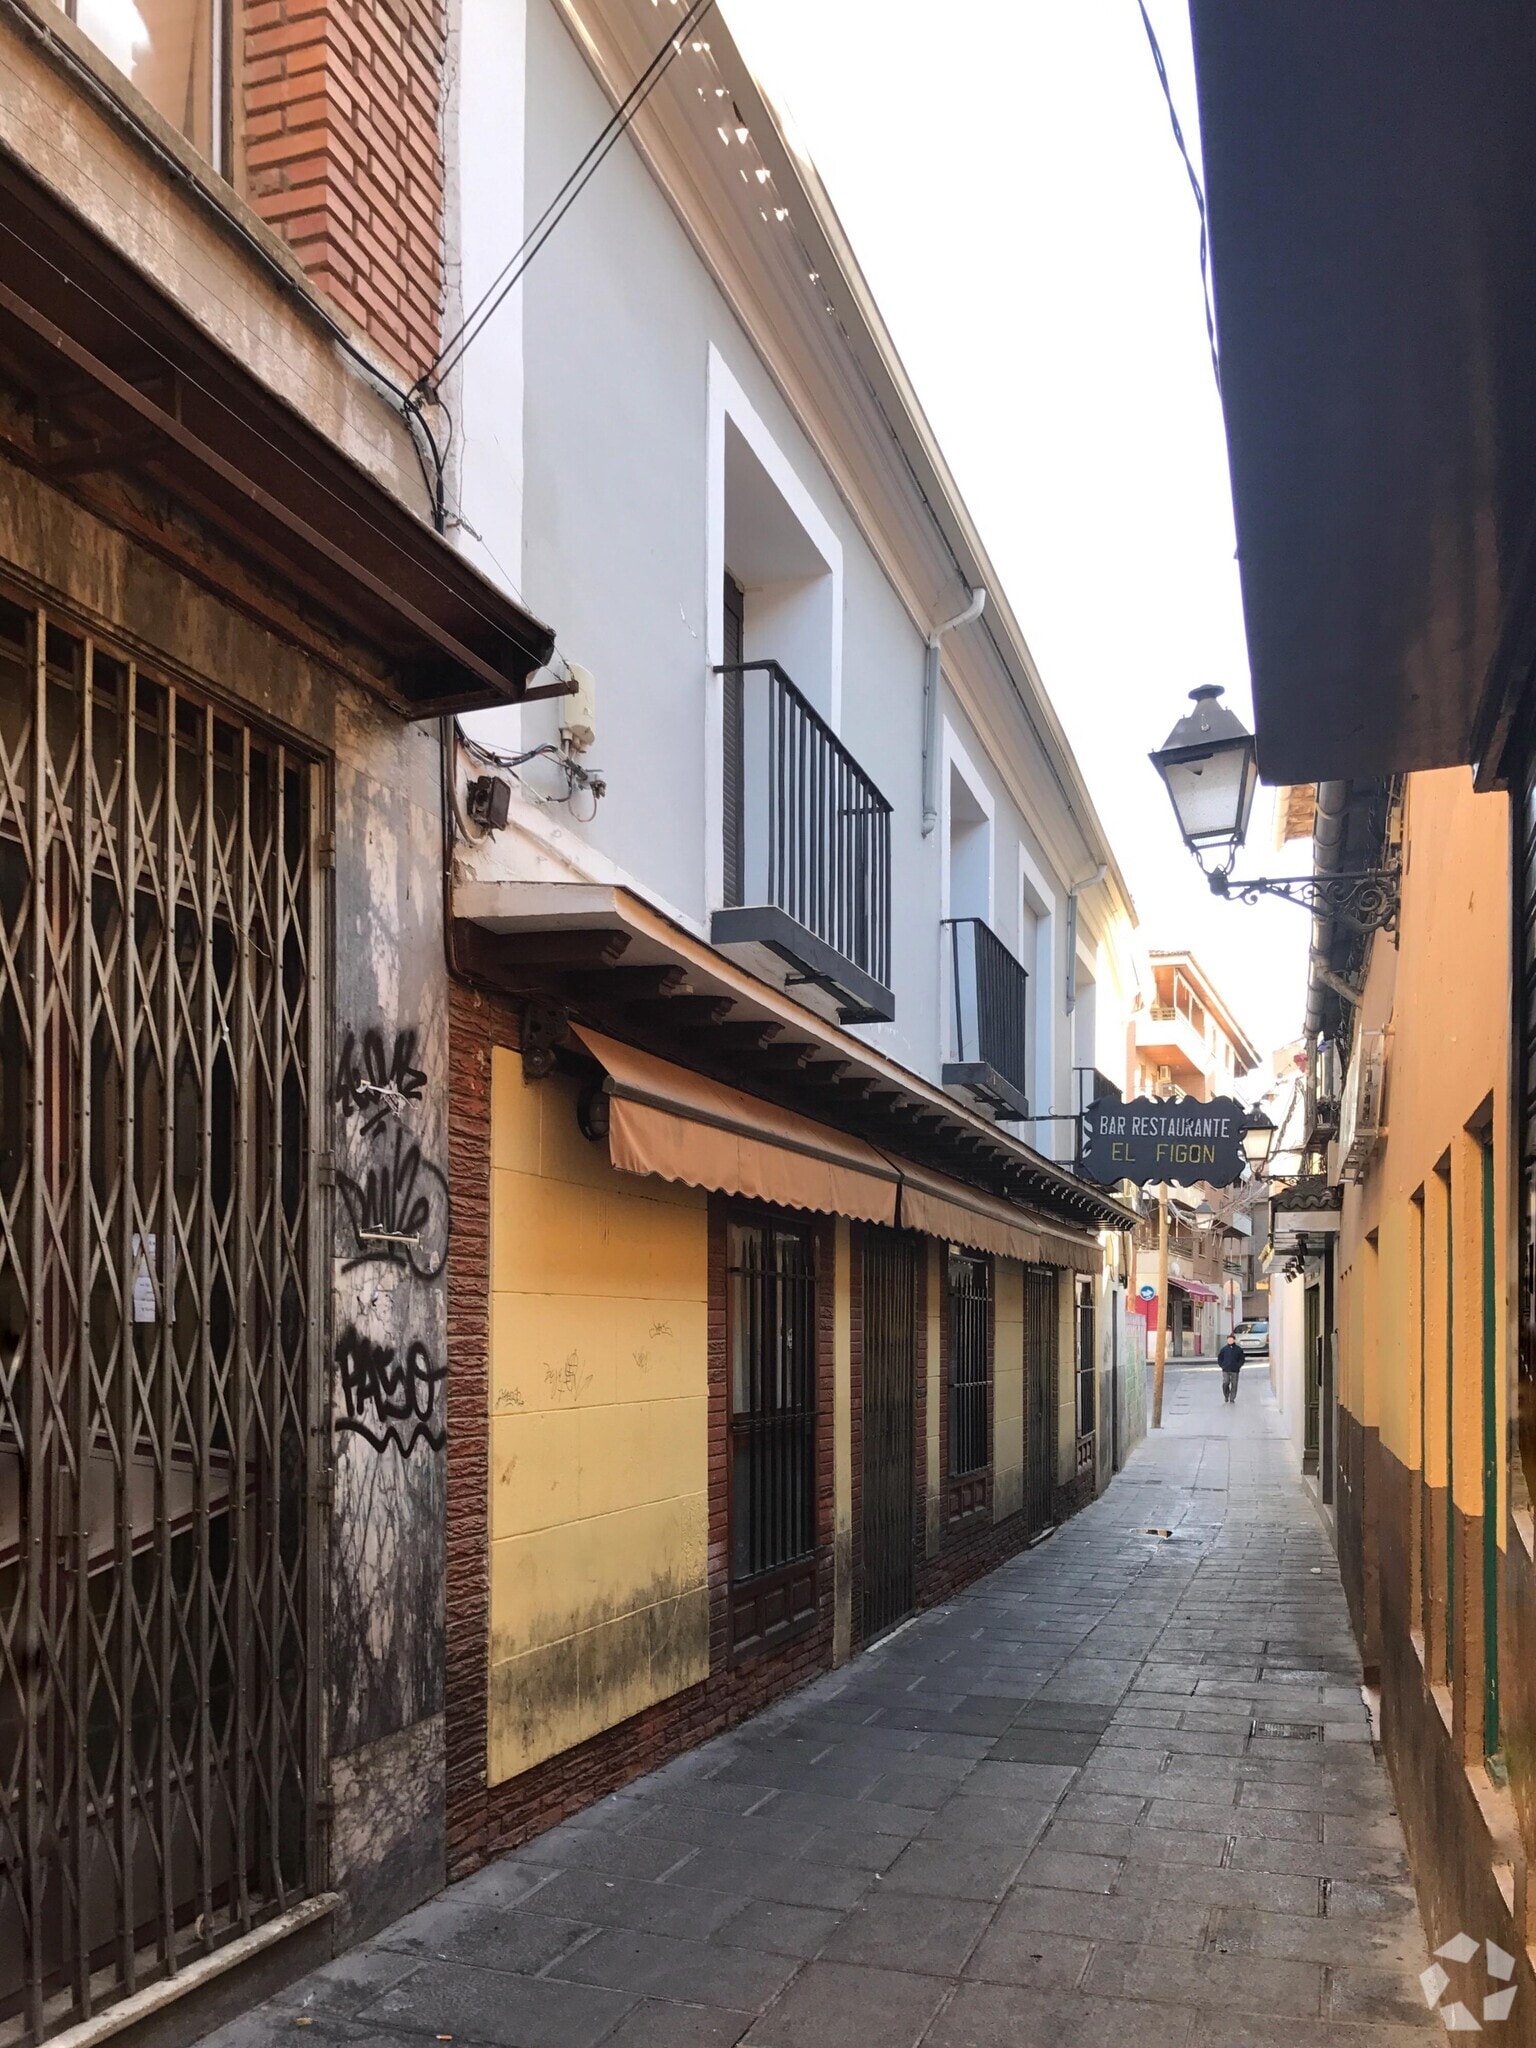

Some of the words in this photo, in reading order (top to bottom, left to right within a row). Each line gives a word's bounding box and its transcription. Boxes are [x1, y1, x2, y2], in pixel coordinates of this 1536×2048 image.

[1100, 1115, 1126, 1136] BAR
[1132, 1116, 1230, 1138] RESTAURANTE
[1111, 1142, 1136, 1162] EL
[1156, 1143, 1216, 1164] FIGON
